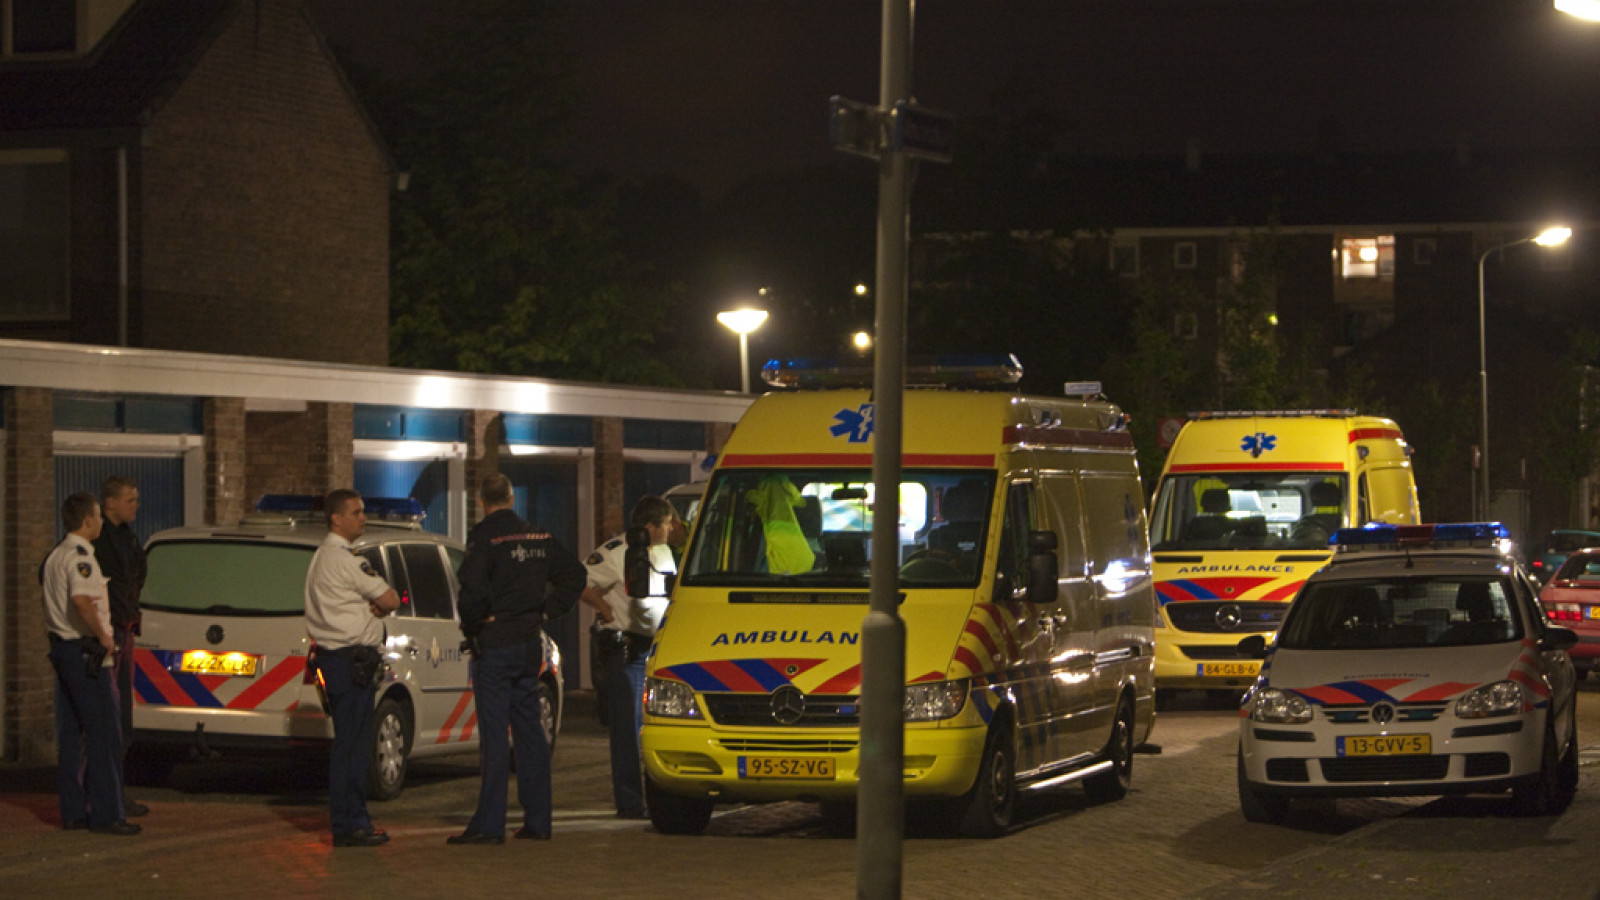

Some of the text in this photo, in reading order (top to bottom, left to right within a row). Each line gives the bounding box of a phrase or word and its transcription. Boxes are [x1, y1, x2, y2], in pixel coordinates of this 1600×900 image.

[1178, 565, 1294, 574] AMBULANCE
[711, 630, 859, 646] AMBULAN
[1353, 737, 1423, 753] 13-GVV-5
[752, 759, 828, 775] 95-SZ-VG
